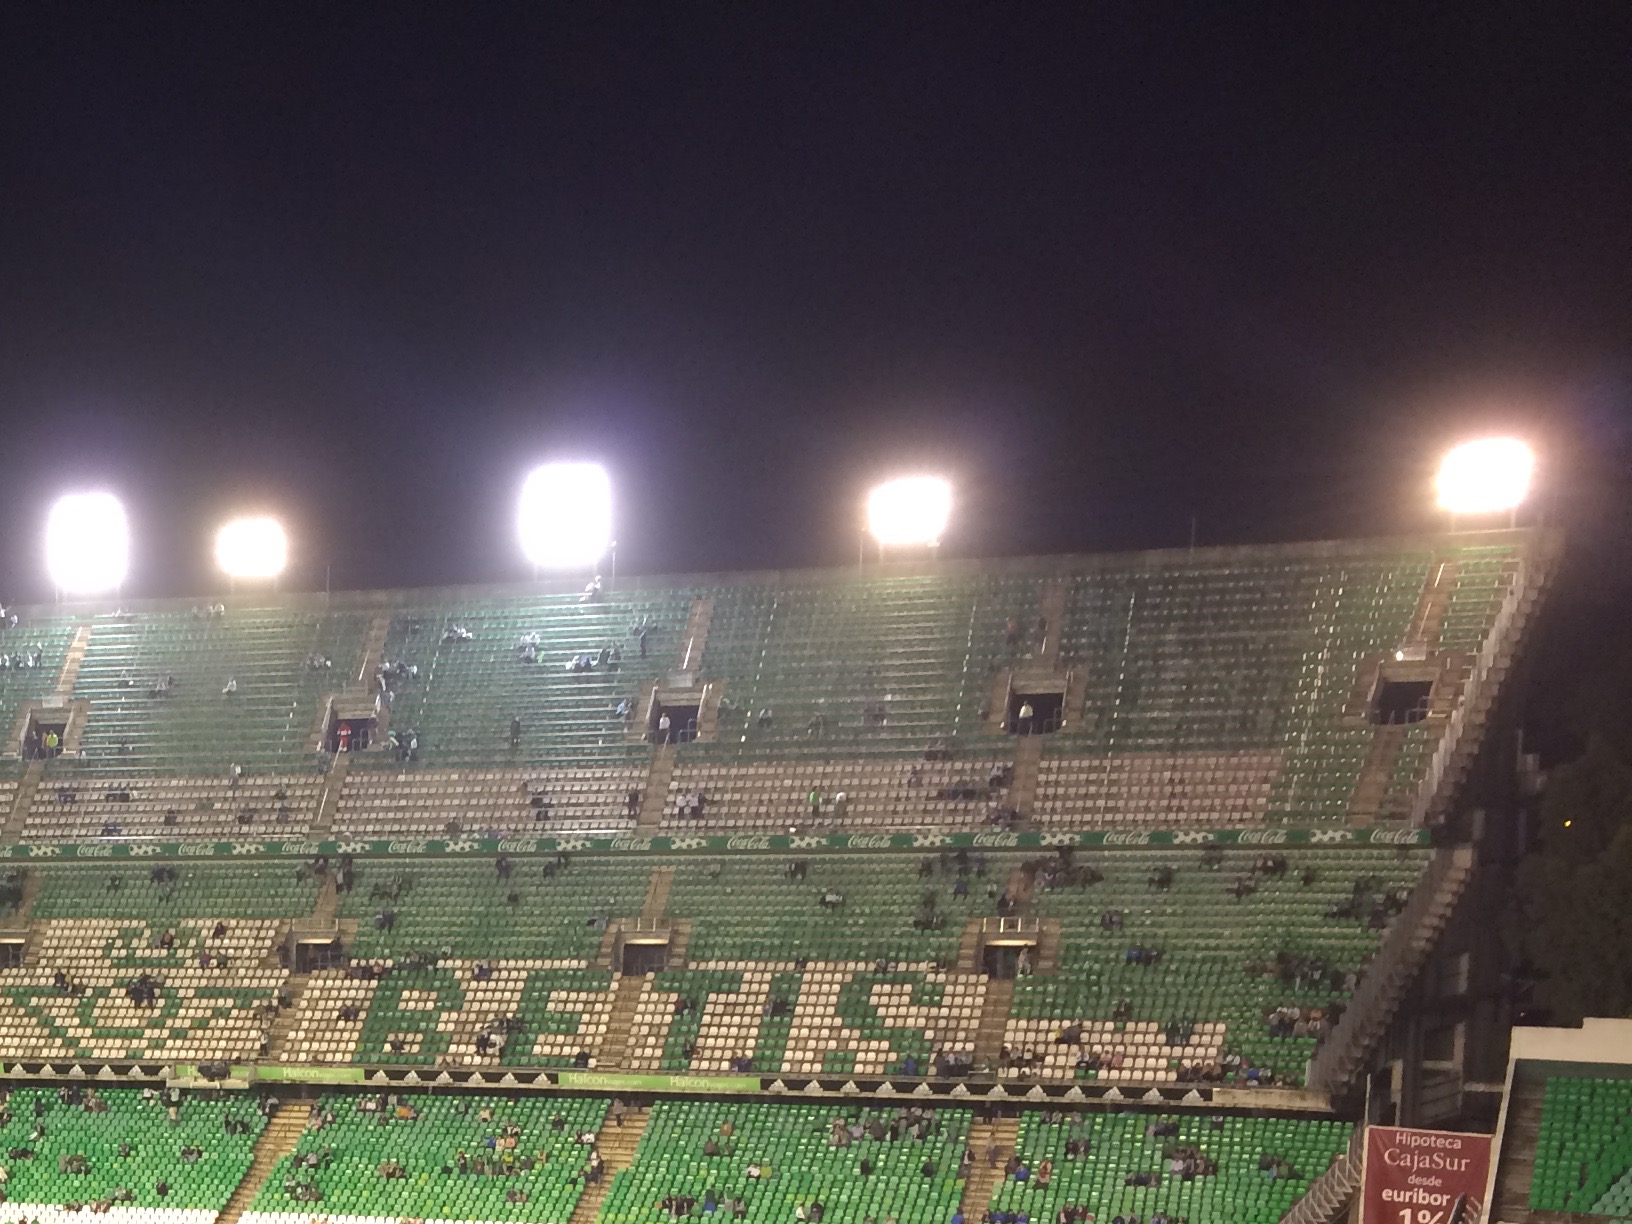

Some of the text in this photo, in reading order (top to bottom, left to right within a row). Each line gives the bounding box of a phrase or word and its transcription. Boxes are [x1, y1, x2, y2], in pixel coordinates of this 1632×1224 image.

[352, 968, 944, 1075] BETIS
[1395, 1132, 1462, 1149] Hipoteca
[1384, 1147, 1470, 1172] CajaSur
[1407, 1174, 1443, 1187] desde
[1381, 1188, 1451, 1206] euribor
